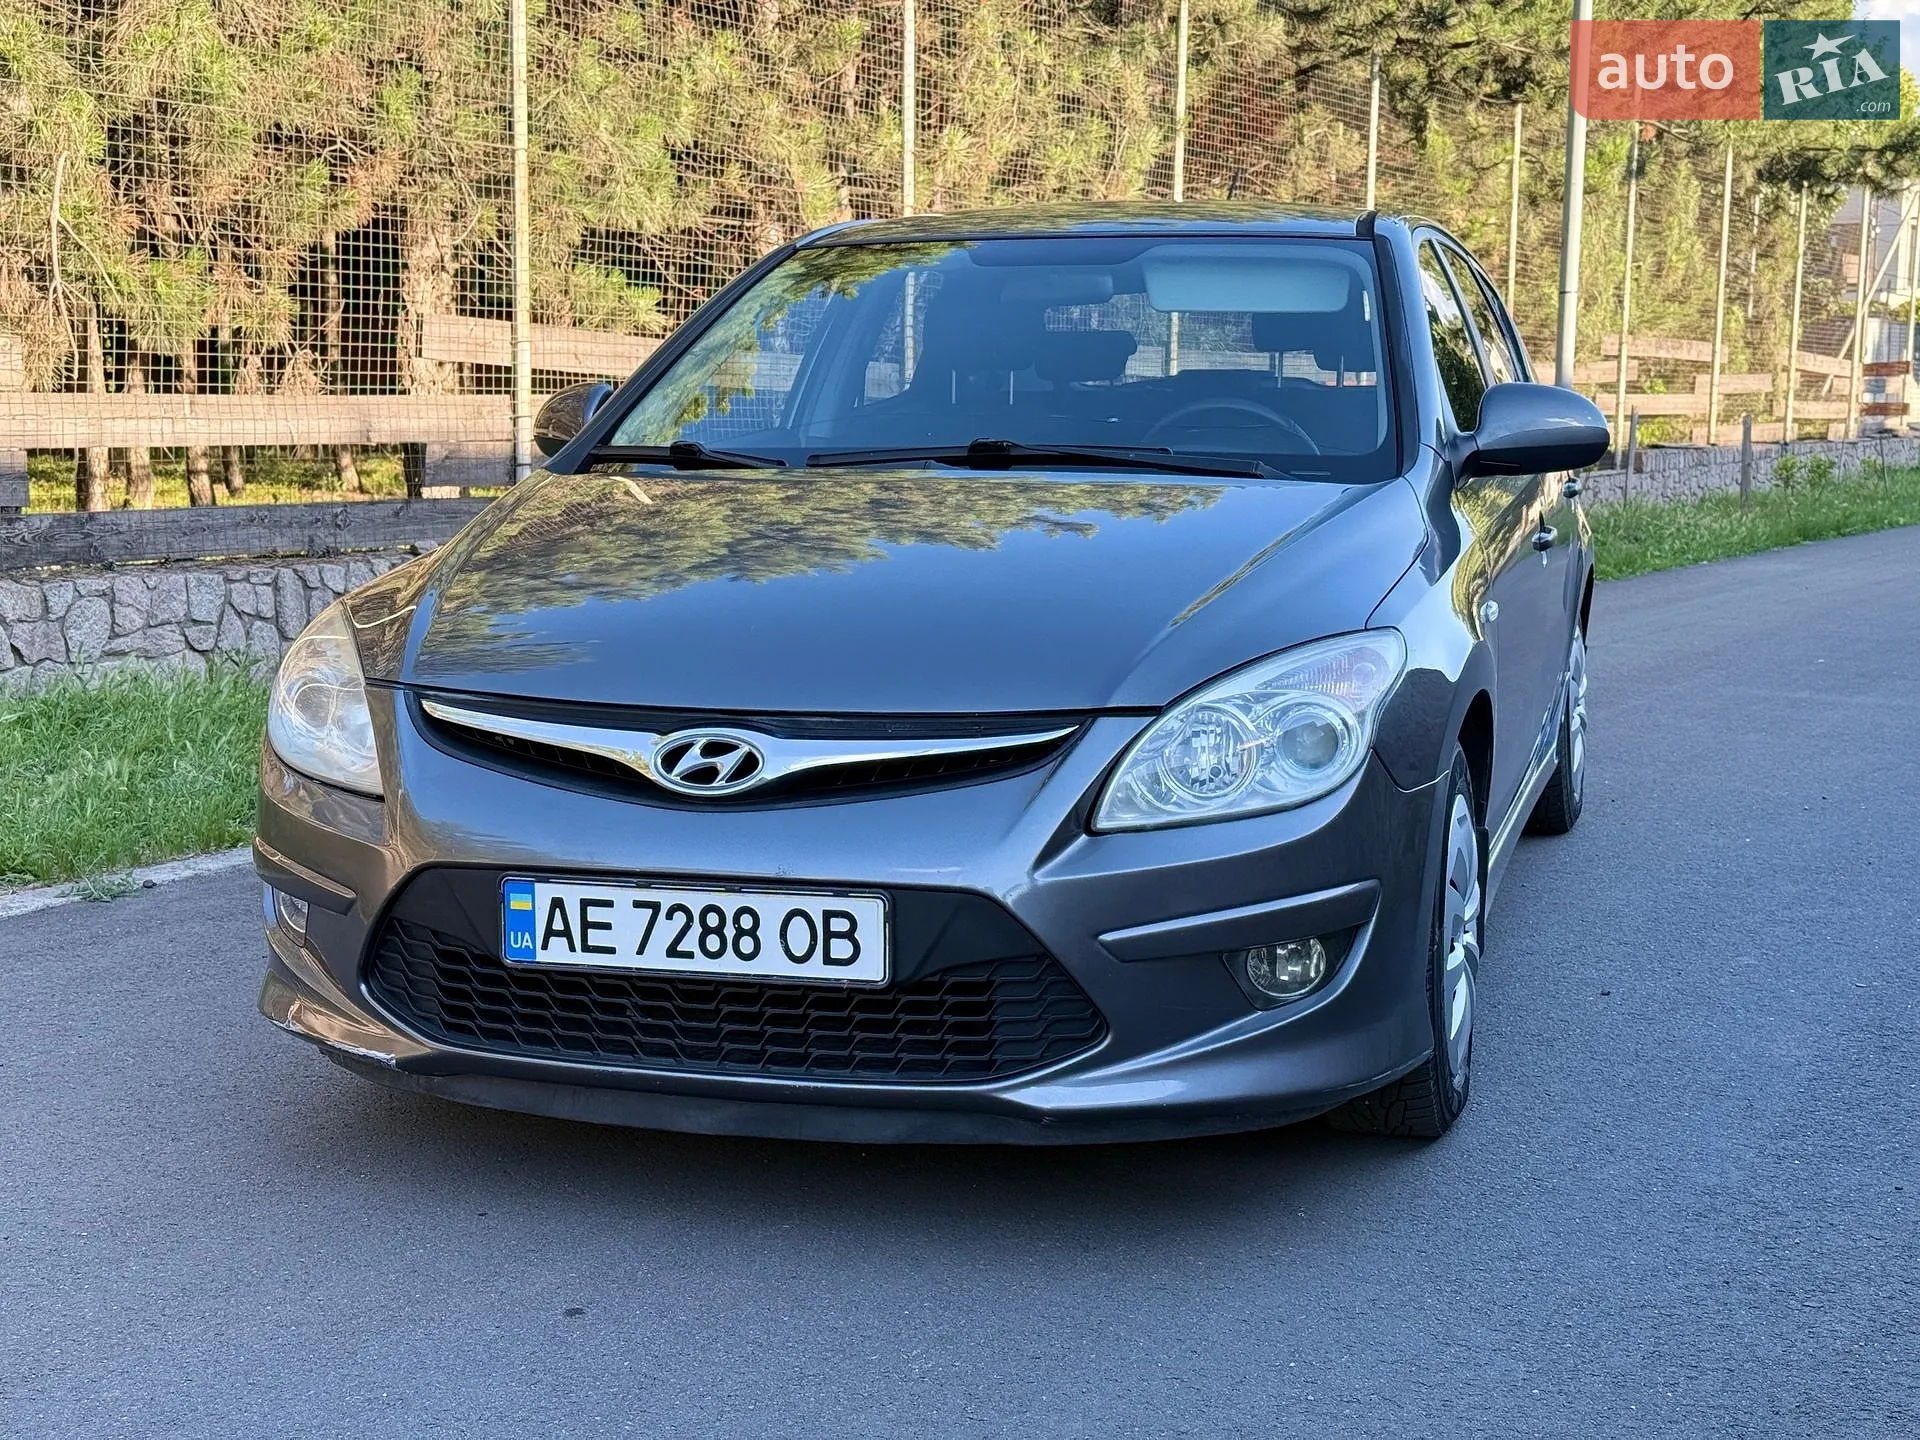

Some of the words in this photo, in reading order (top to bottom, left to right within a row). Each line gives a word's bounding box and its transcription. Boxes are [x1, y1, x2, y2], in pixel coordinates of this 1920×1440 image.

[510, 931, 534, 949] UA
[540, 897, 617, 955] AE
[632, 899, 762, 962] 7288
[779, 907, 862, 967] OB
